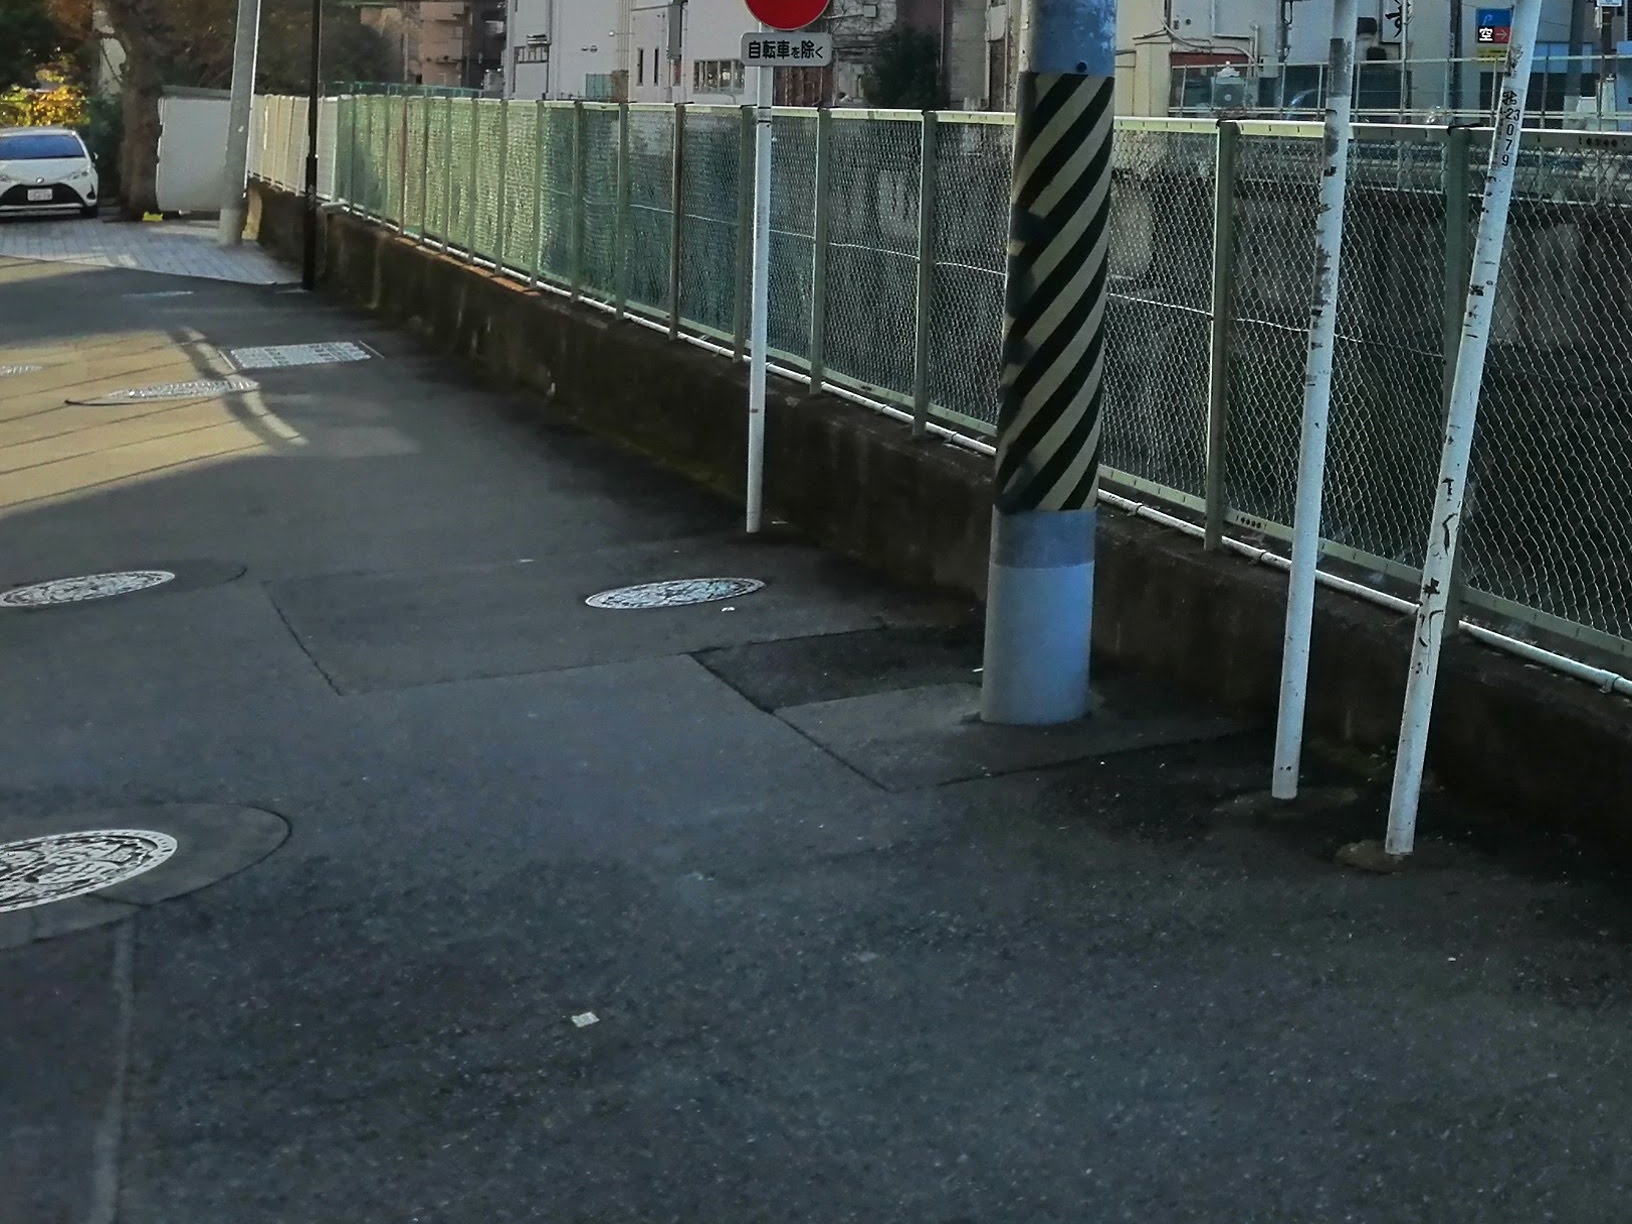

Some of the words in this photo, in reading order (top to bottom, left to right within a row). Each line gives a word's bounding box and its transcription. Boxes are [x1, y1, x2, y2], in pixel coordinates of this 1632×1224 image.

[1479, 26, 1494, 42] 空
[748, 39, 824, 60] 自転車を除く
